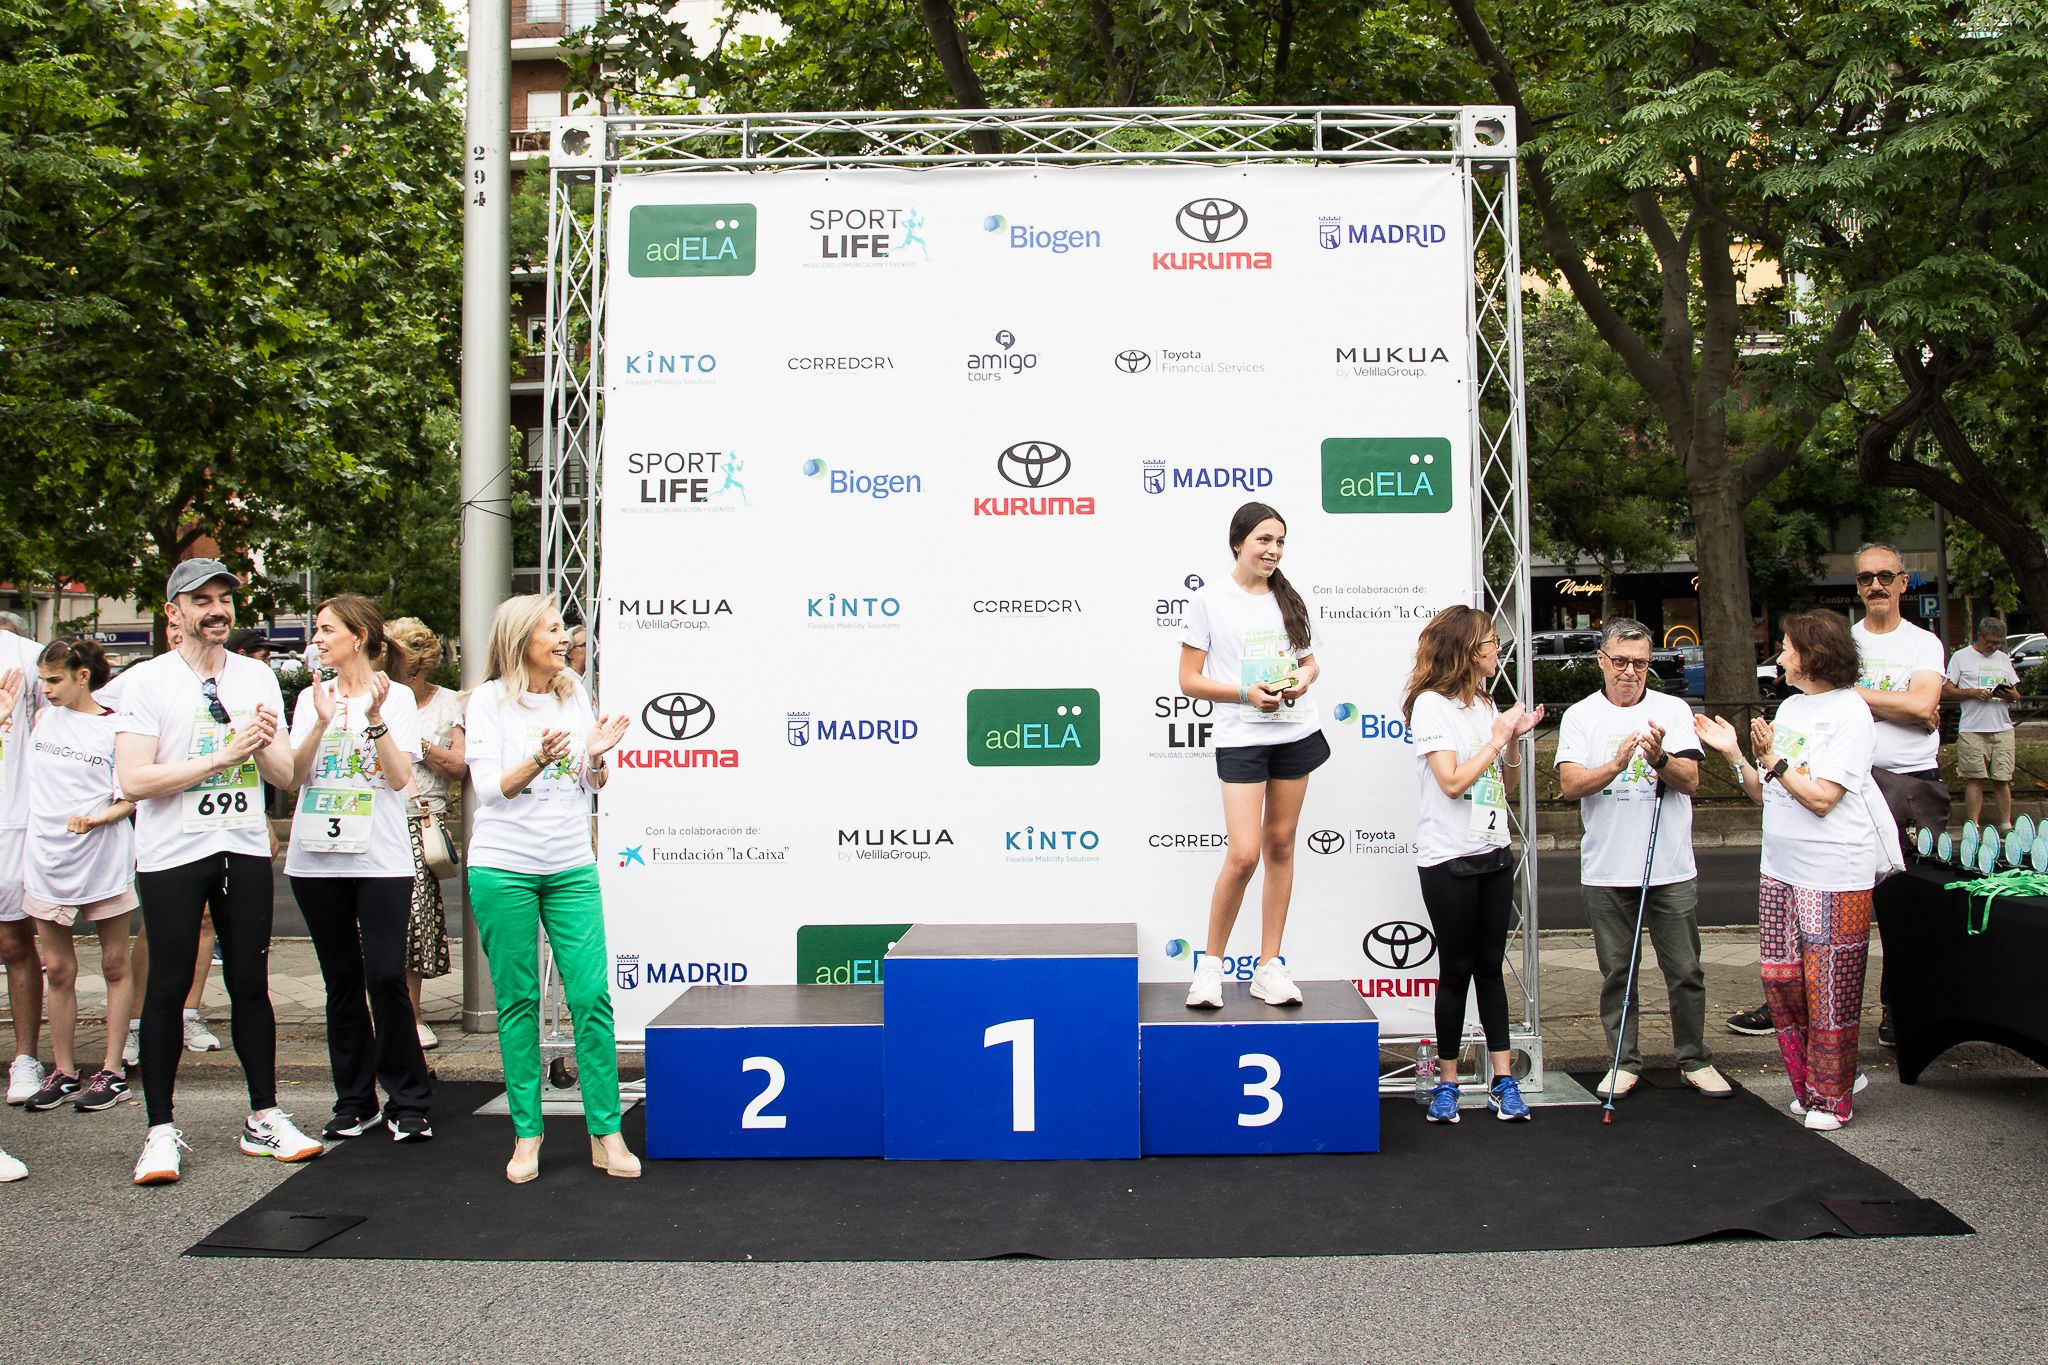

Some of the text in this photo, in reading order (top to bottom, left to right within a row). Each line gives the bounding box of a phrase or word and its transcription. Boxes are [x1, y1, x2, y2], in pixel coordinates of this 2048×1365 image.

[810, 209, 902, 230] SPORT
[823, 235, 889, 258] LIFE
[1010, 225, 1101, 253] Biogen
[1349, 225, 1445, 248] MADRID
[646, 236, 738, 263] adELA
[967, 353, 1037, 375] amigo
[1162, 350, 1201, 361] Toyota
[1337, 348, 1449, 362] MUKUA
[968, 372, 1001, 381] tours
[1163, 360, 1265, 373] Financial Services
[629, 452, 723, 473] SPORT
[831, 470, 920, 499] Biogen
[1174, 468, 1272, 492] MADRID
[1340, 471, 1434, 497] adELA
[641, 479, 708, 503] LIFE
[1312, 585, 1428, 594] Con la colaboración de:
[620, 599, 733, 615] MUKUA
[1320, 606, 1391, 619] Fundación
[1925, 599, 1935, 615] P
[807, 622, 900, 631] Flexible Mobility Solutions
[1157, 617, 1182, 627] tour
[1155, 696, 1213, 717] SPO
[818, 720, 918, 744] MADRID
[986, 724, 1081, 749] adELA
[1168, 722, 1213, 748] LIF
[35, 742, 104, 766] elillaGroup.
[198, 791, 248, 816] 698
[327, 818, 342, 838] 3
[1487, 810, 1497, 830] 2
[645, 826, 761, 836] Con la colaboración de:
[839, 829, 954, 845] MUKUA
[1356, 830, 1395, 842] Toyota
[652, 847, 724, 861] Fundación
[1006, 855, 1100, 863] Flexible Mobility Solutions
[1356, 843, 1409, 854] Financial
[647, 962, 747, 985] MADRID
[816, 960, 884, 984] adEL
[984, 1018, 1035, 1132] 1
[741, 1056, 787, 1129] 2
[1237, 1053, 1284, 1127] 3
